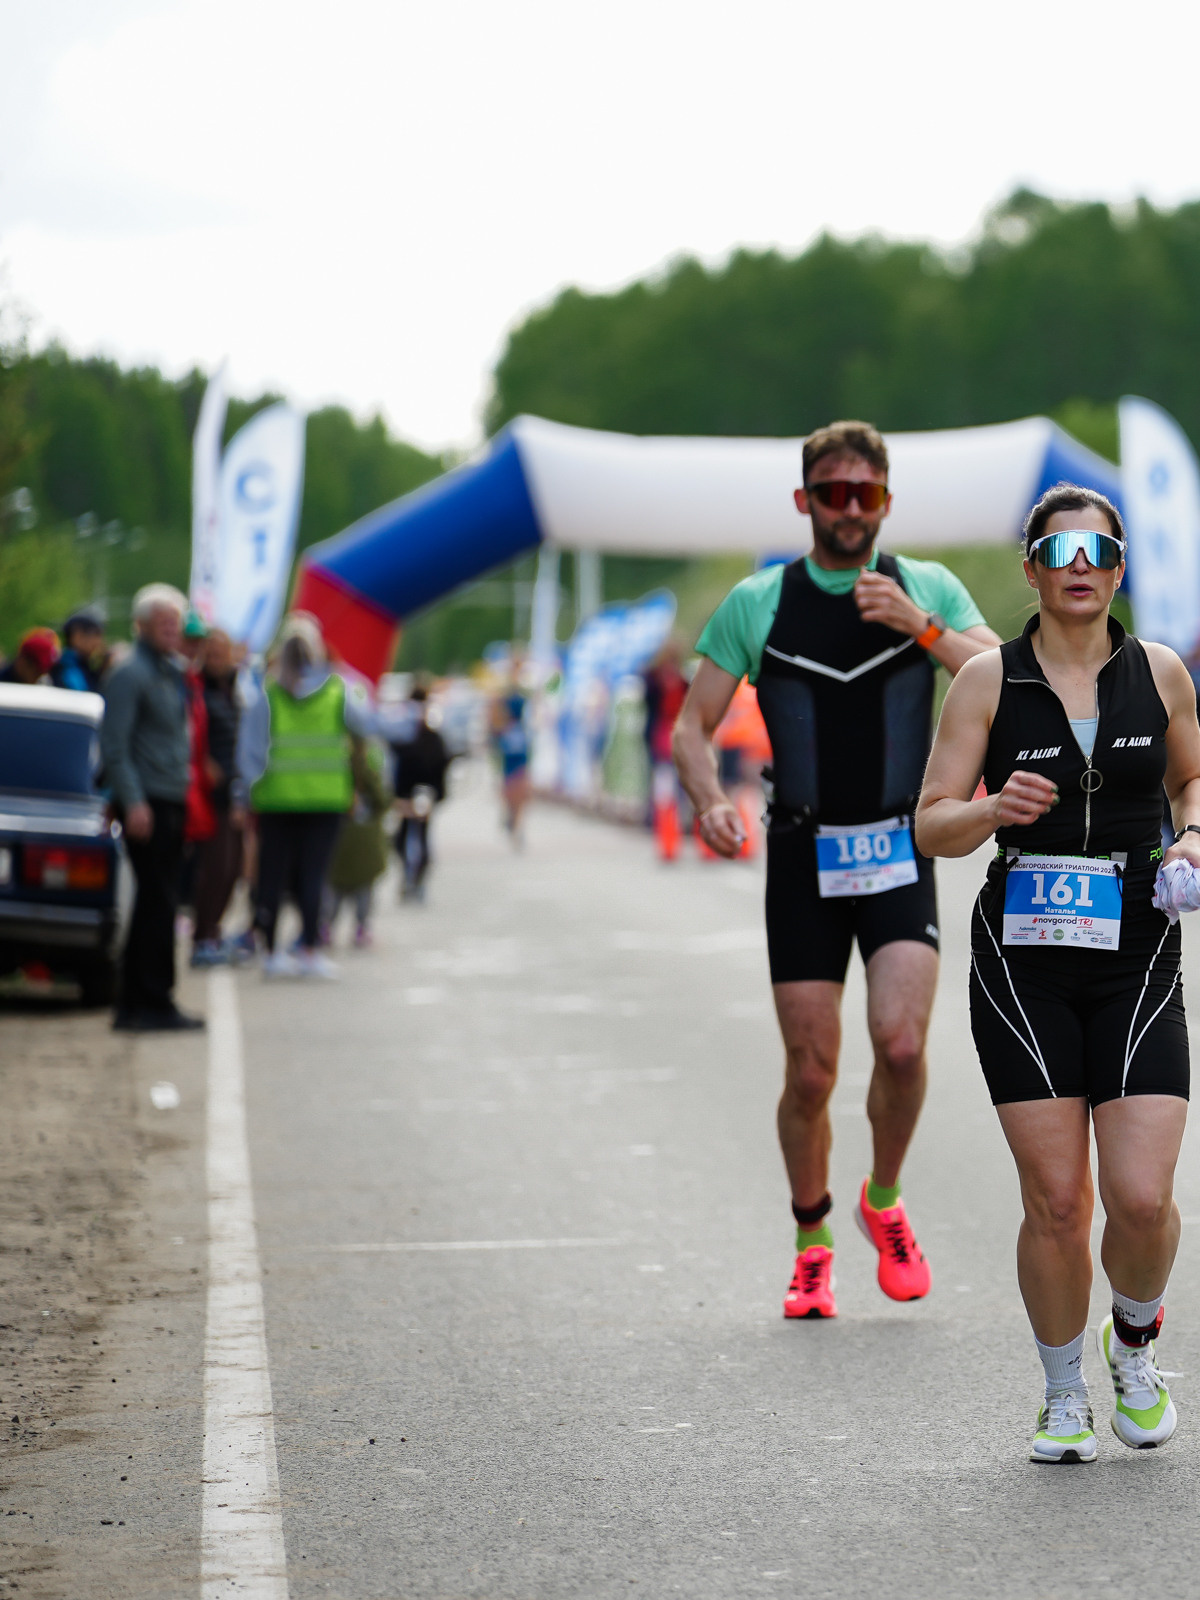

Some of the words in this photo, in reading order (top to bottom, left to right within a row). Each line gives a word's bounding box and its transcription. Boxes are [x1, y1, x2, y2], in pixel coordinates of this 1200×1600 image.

[1127, 736, 1153, 747] ALIEN
[1029, 746, 1062, 760] ALIEN
[836, 833, 892, 864] 180
[1014, 862, 1063, 870] НОВГОРОДСКИЙ
[1064, 863, 1100, 873] ТРИАТЛОН
[1100, 867, 1116, 875] 2023
[1031, 873, 1093, 907] 161
[1044, 906, 1077, 915] Наталья
[1032, 916, 1078, 926] #novgorod
